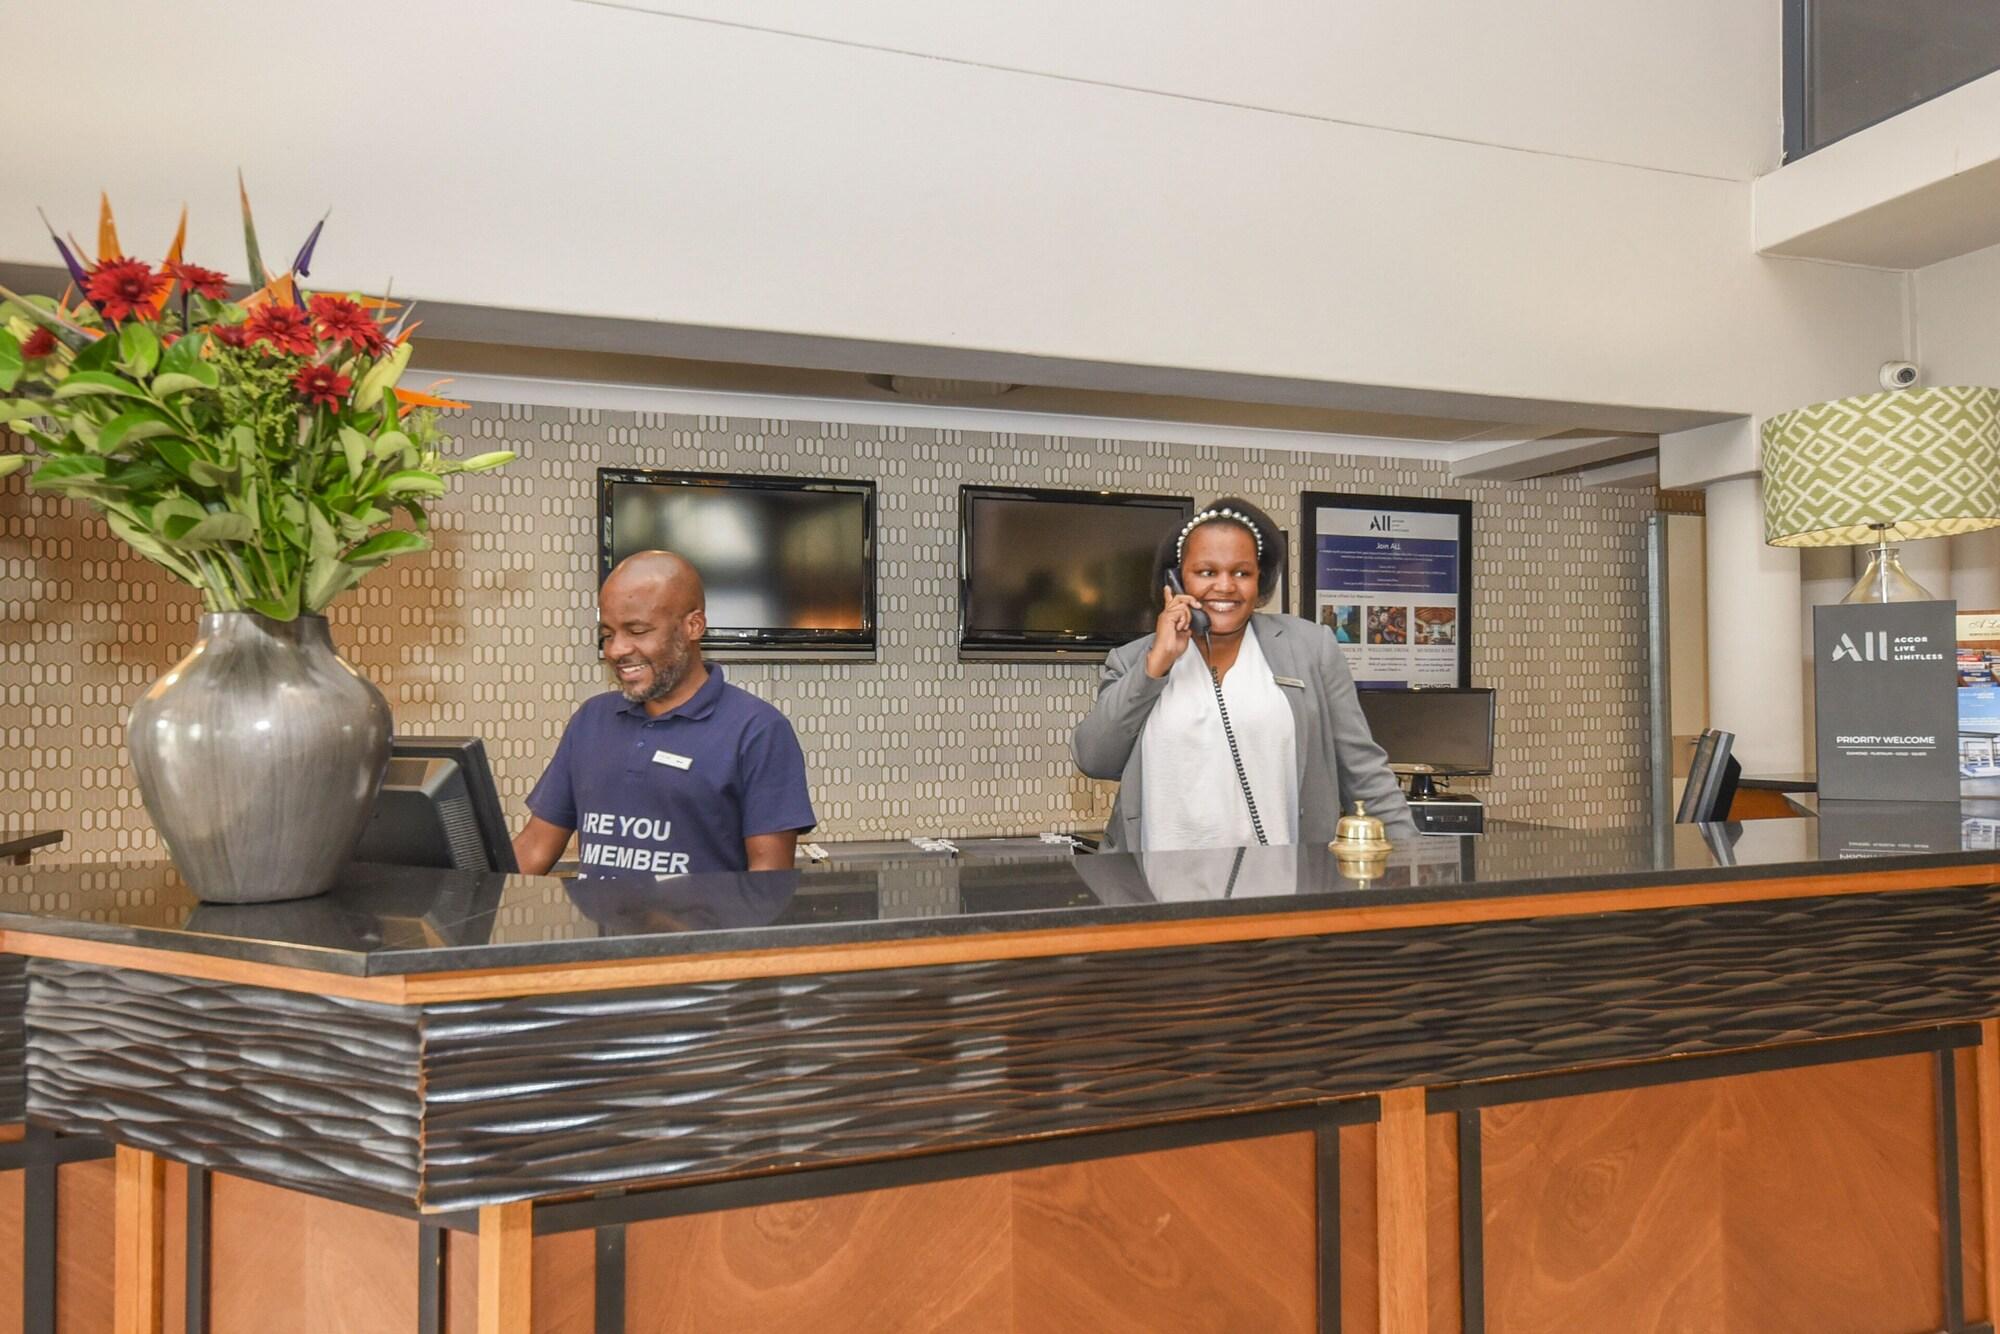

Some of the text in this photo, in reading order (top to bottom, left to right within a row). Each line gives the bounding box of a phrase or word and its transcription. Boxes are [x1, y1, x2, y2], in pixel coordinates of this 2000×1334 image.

[1369, 515, 1391, 531] All
[1831, 631, 1889, 662] All
[1894, 653, 1943, 661] LIMITLESS
[1836, 736, 1936, 744] PRIORITY WELCOME
[619, 816, 671, 841] YOU
[583, 843, 690, 874] MEMBER
